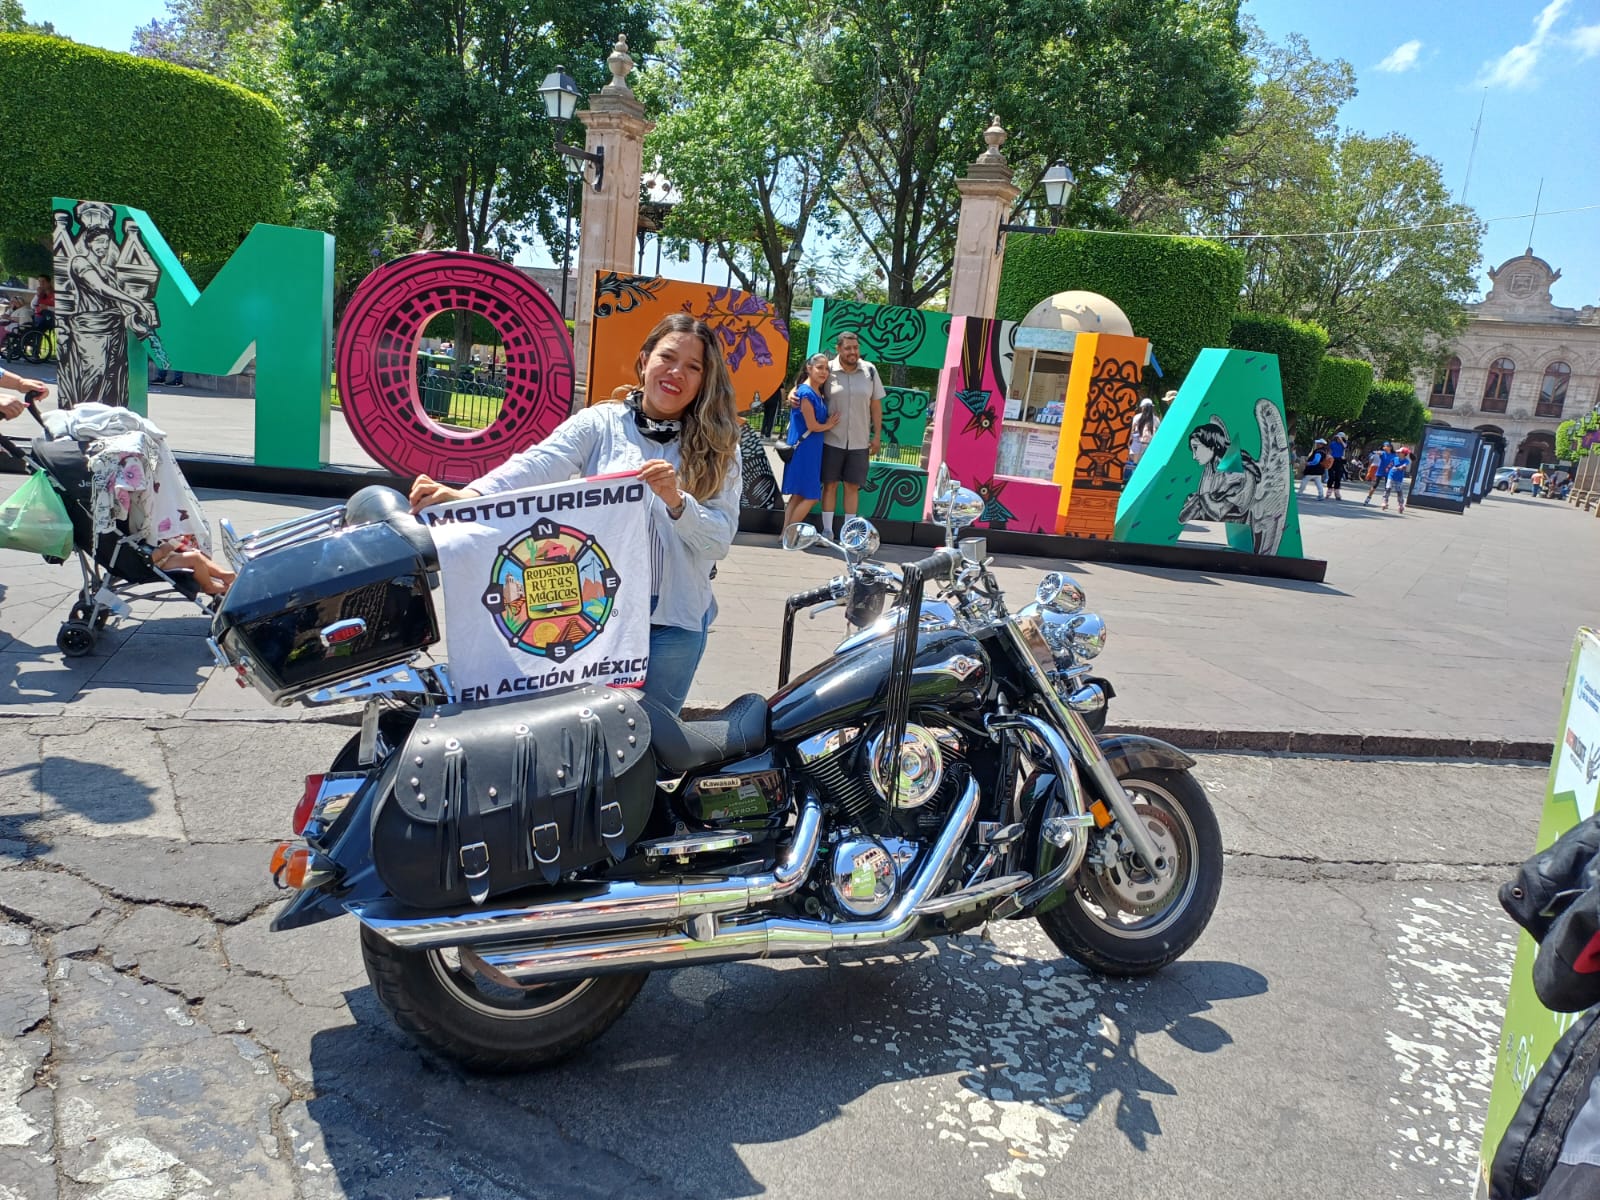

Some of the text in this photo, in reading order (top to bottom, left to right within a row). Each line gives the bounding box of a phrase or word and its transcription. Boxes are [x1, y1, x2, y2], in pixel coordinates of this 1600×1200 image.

[426, 484, 644, 527] MOTOTURISMO
[538, 523, 553, 535] N
[605, 577, 617, 588] E
[486, 593, 501, 604] O
[554, 646, 567, 657] S
[460, 684, 489, 701] EN
[496, 667, 575, 695] ACCIÓN
[702, 779, 739, 787] Kawasaki
